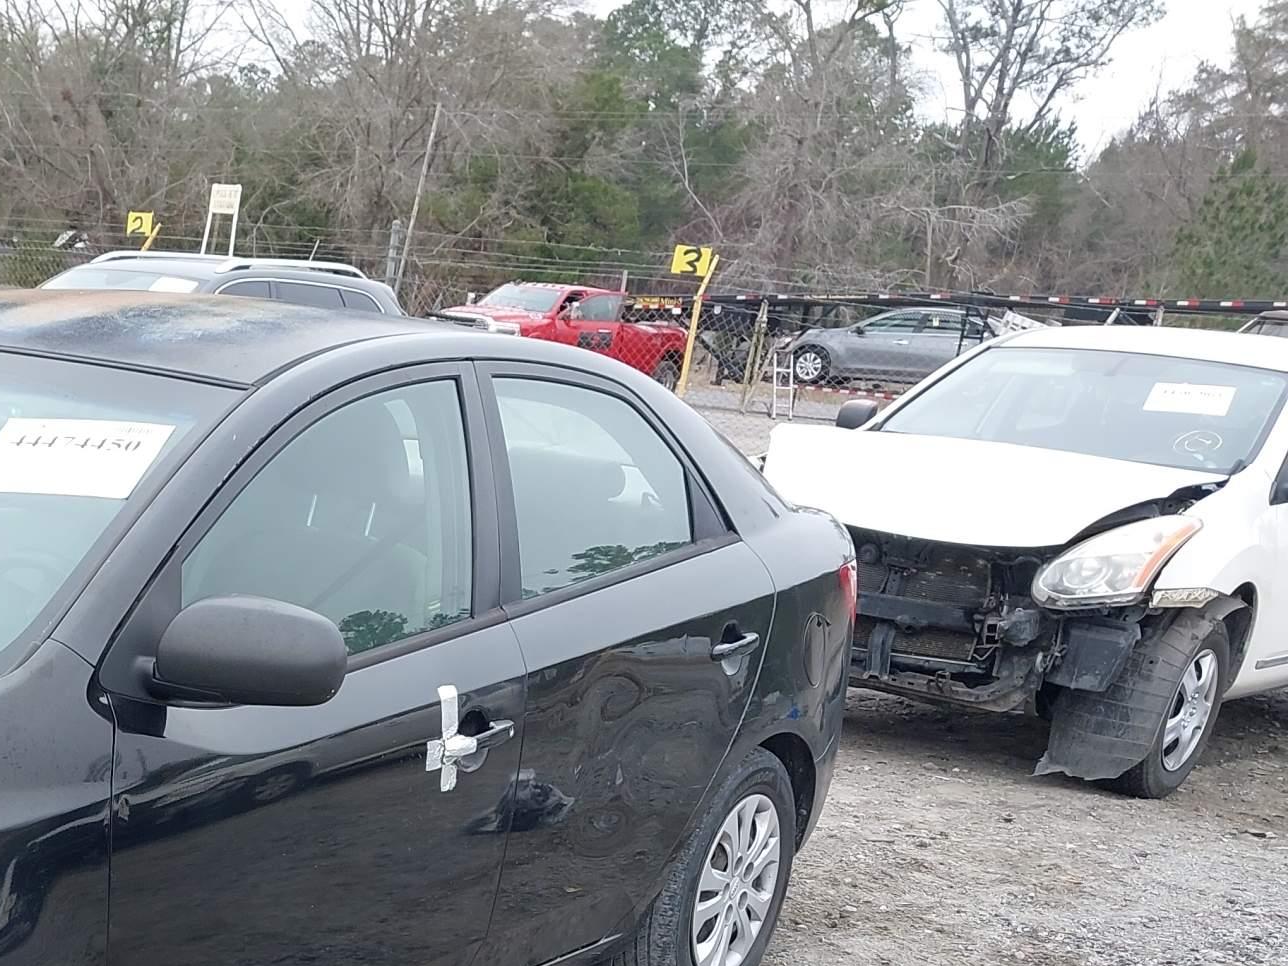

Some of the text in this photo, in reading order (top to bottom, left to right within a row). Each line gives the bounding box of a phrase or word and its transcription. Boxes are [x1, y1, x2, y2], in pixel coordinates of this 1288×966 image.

[129, 216, 146, 235] 2
[680, 247, 702, 274] 3
[9, 434, 141, 452] 44474450
